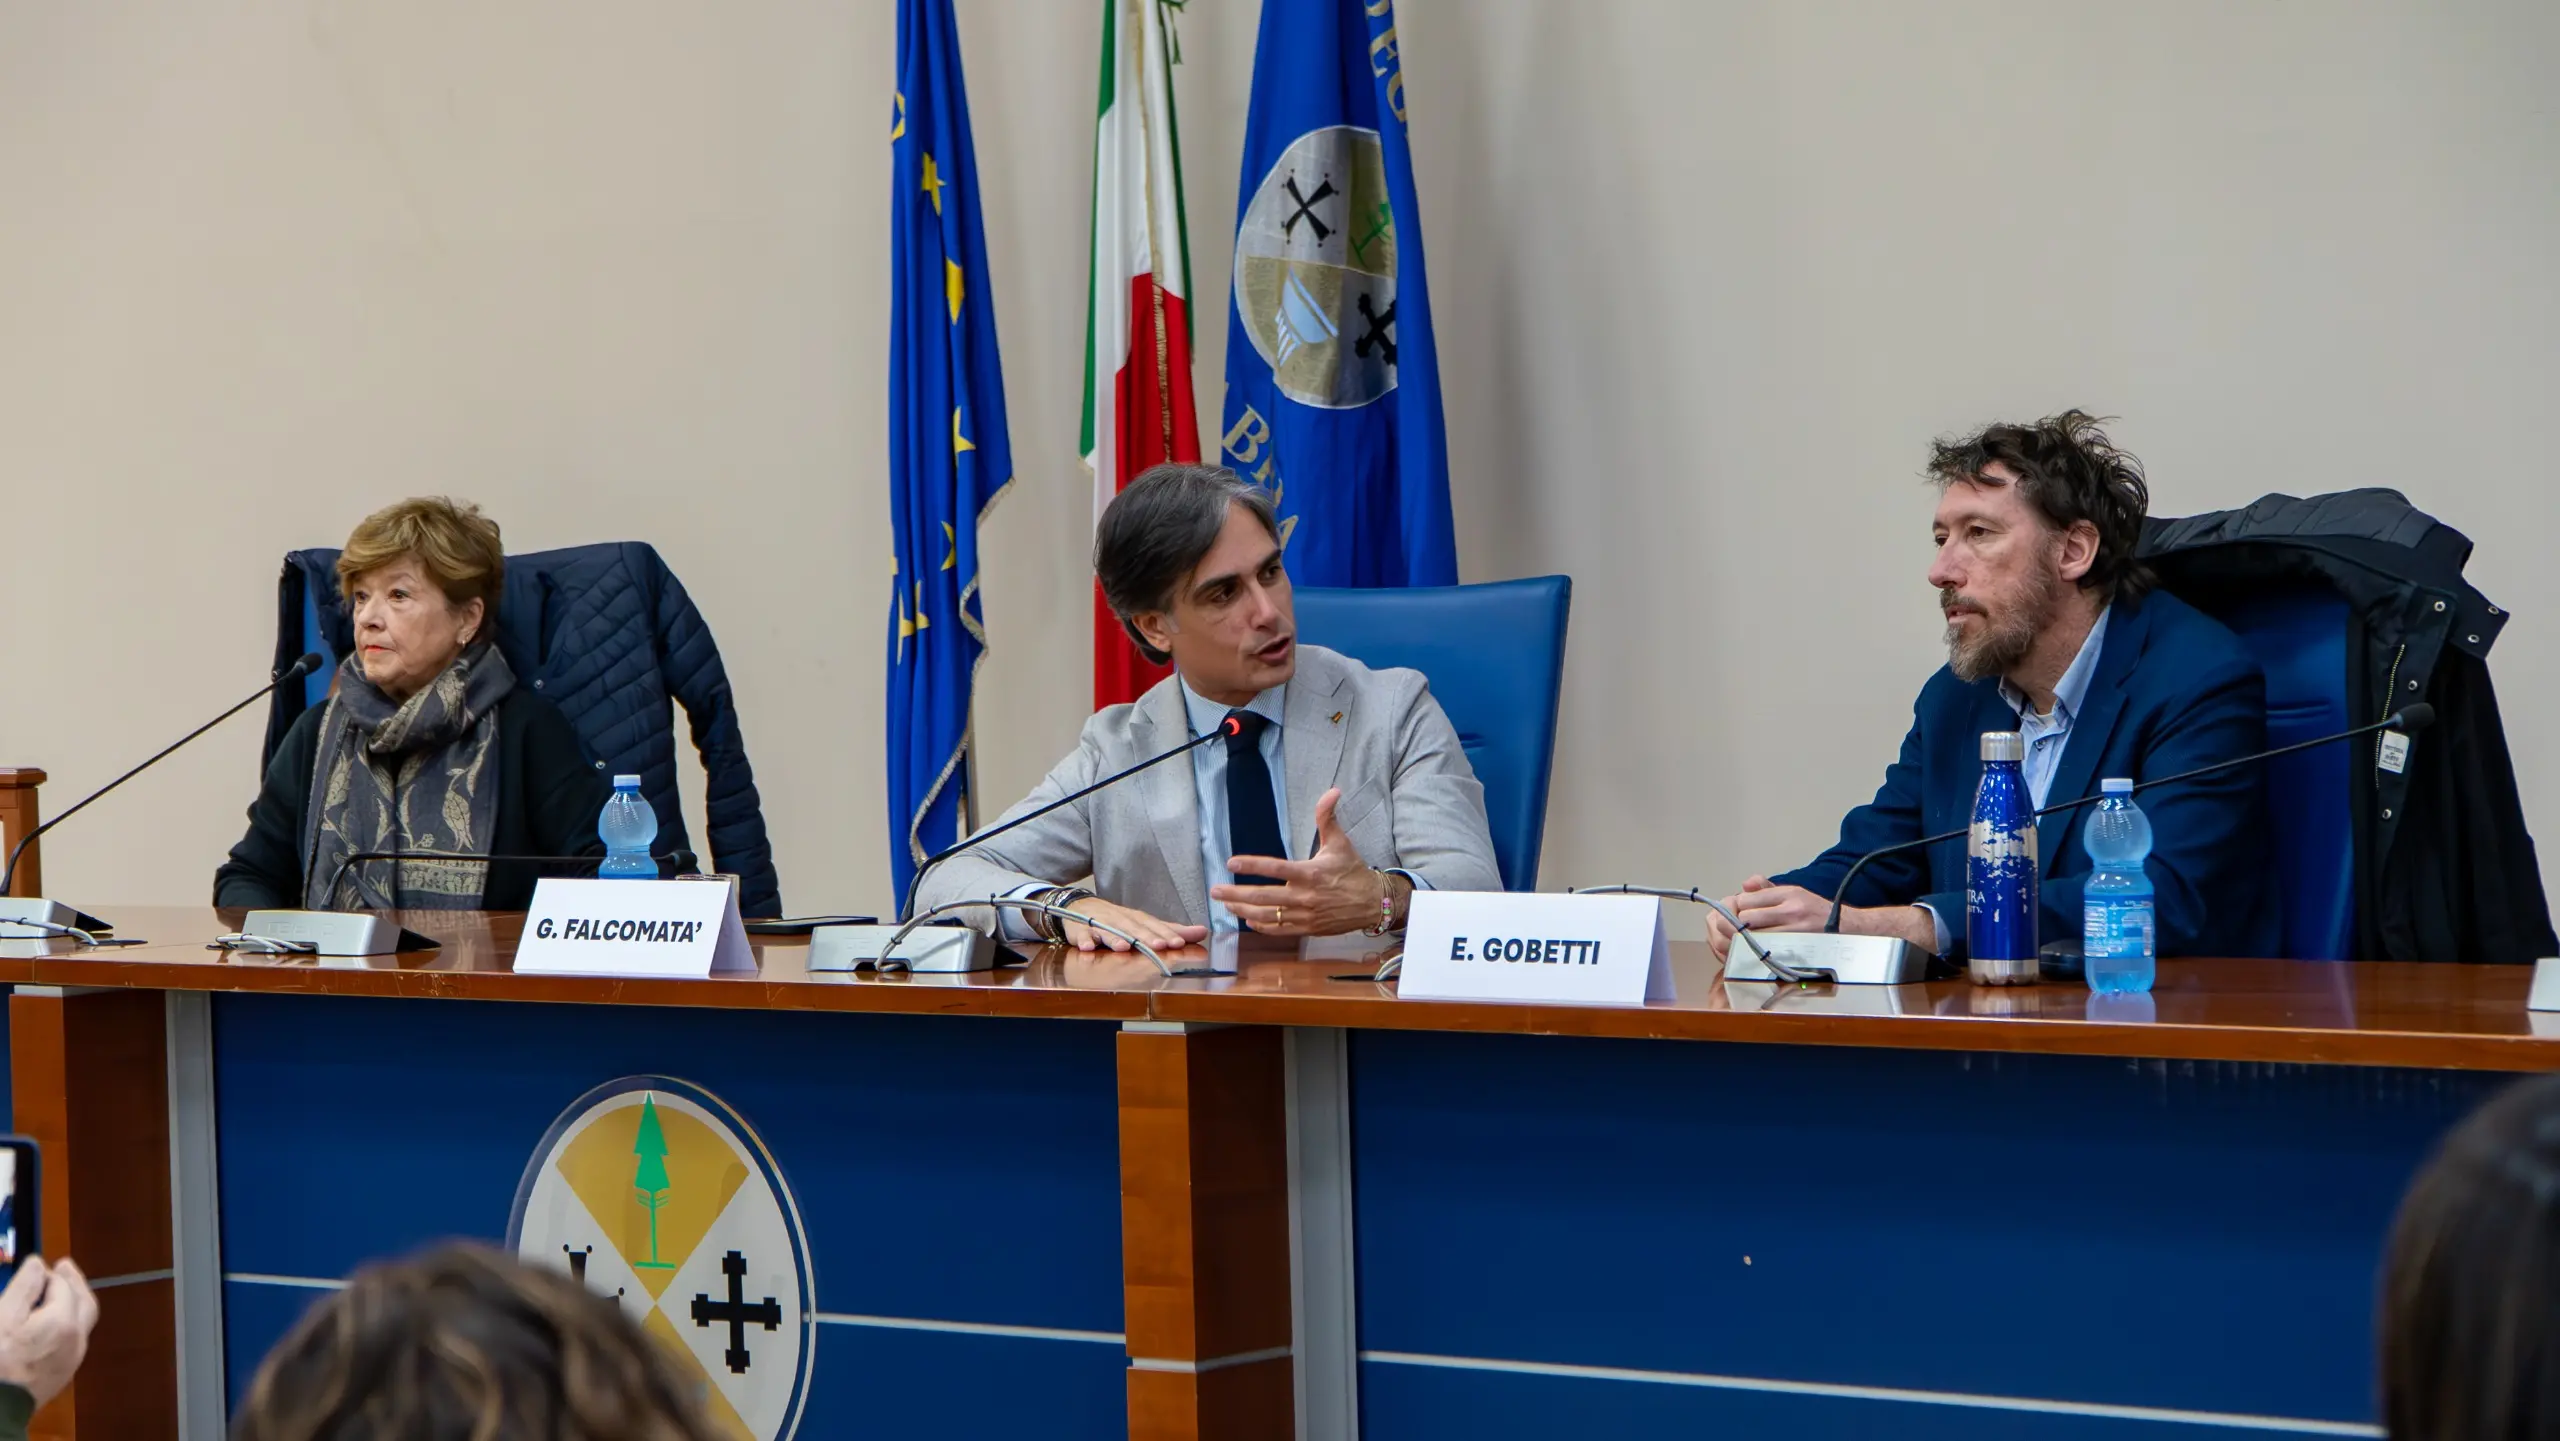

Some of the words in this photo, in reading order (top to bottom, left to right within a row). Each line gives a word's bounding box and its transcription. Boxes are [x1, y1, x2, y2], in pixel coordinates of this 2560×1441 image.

[536, 918, 558, 939] G.
[1450, 937, 1475, 961] E.
[1482, 937, 1601, 965] GOBETTI
